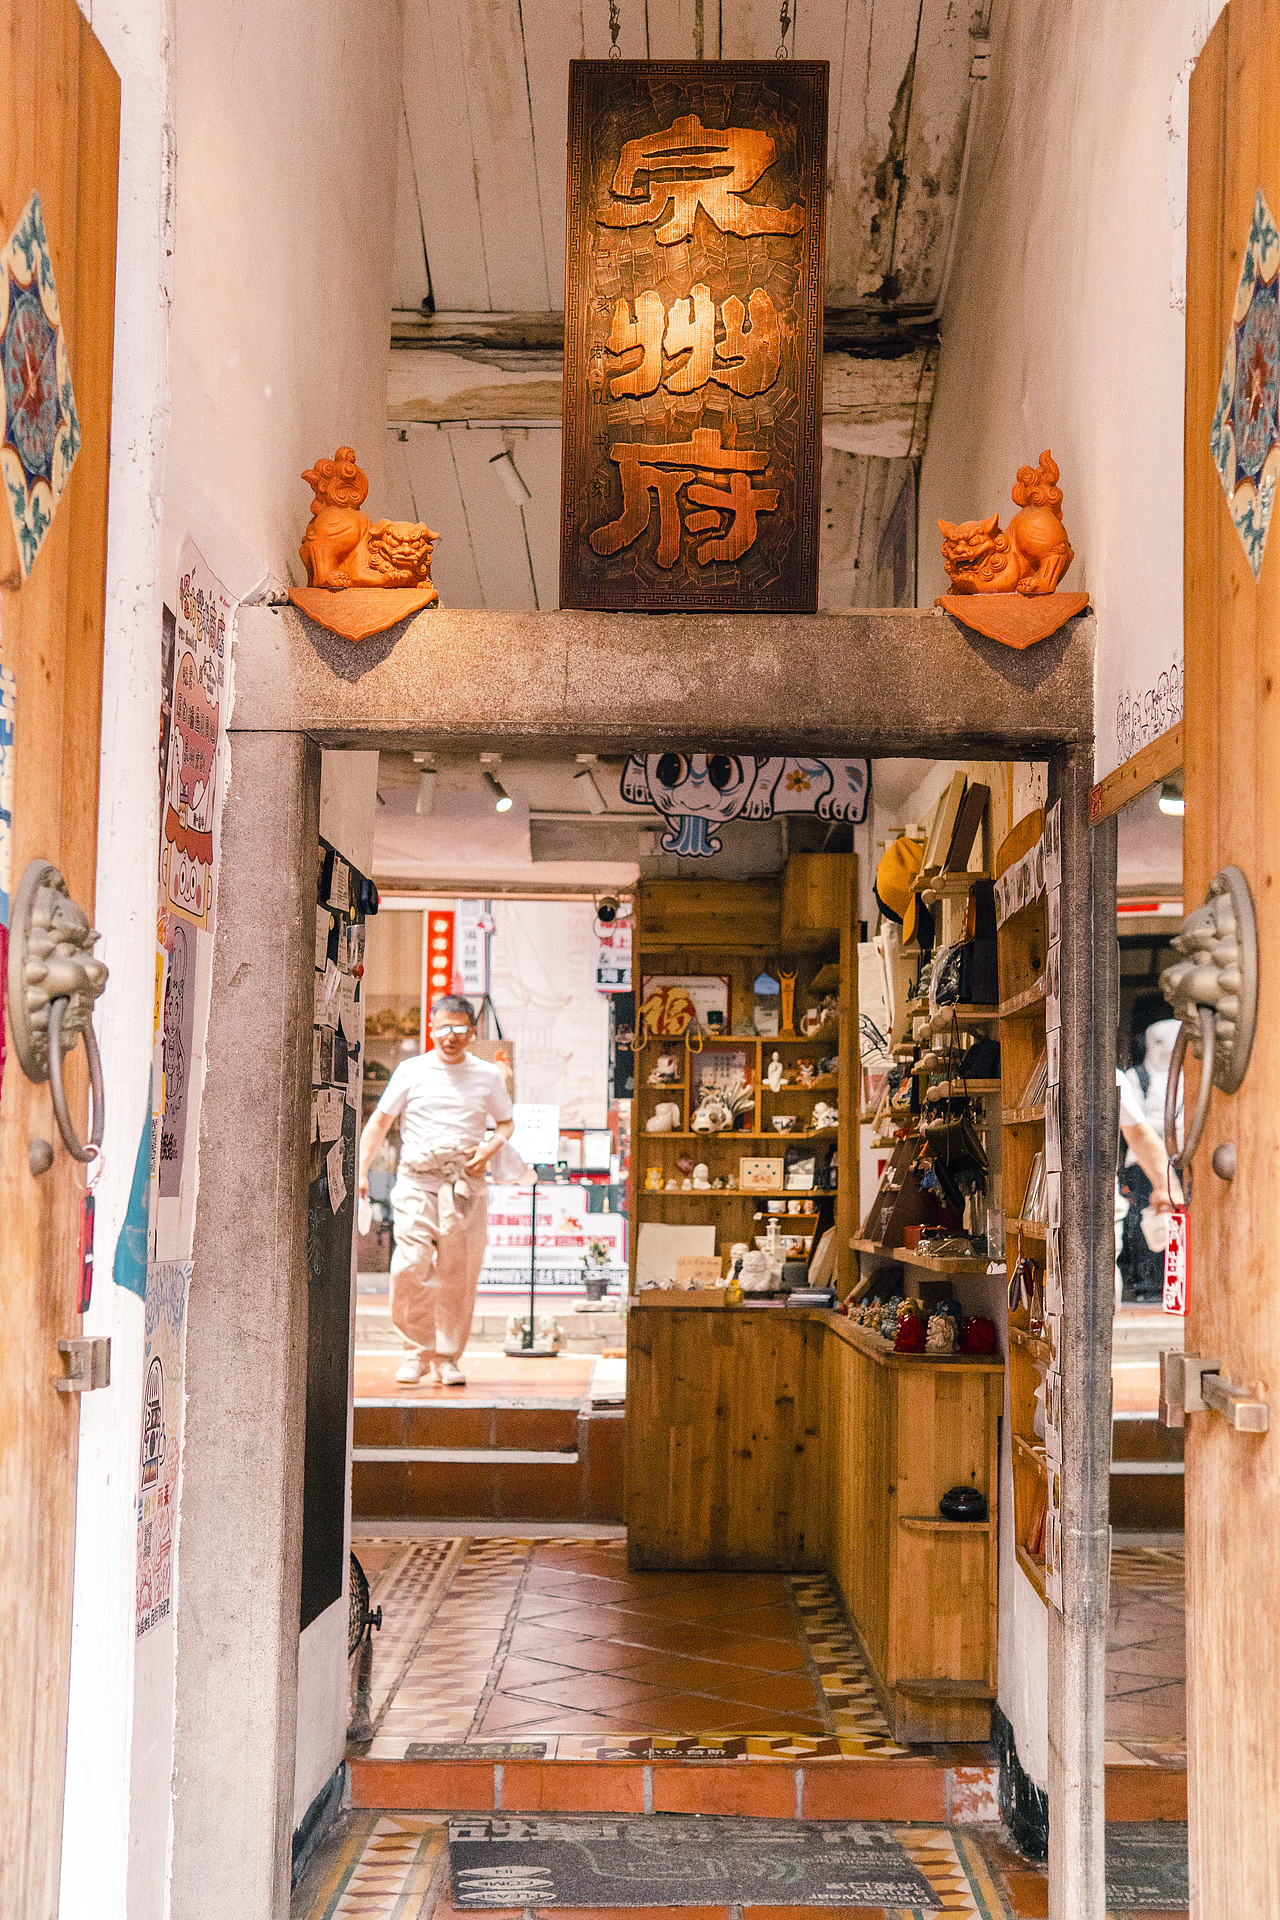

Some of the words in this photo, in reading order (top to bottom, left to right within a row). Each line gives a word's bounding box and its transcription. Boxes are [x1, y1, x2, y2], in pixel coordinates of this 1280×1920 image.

[415, 1743, 533, 1754] 小心台阶
[641, 1748, 727, 1756] 小心台阶
[475, 1892, 540, 1900] PLEASE
